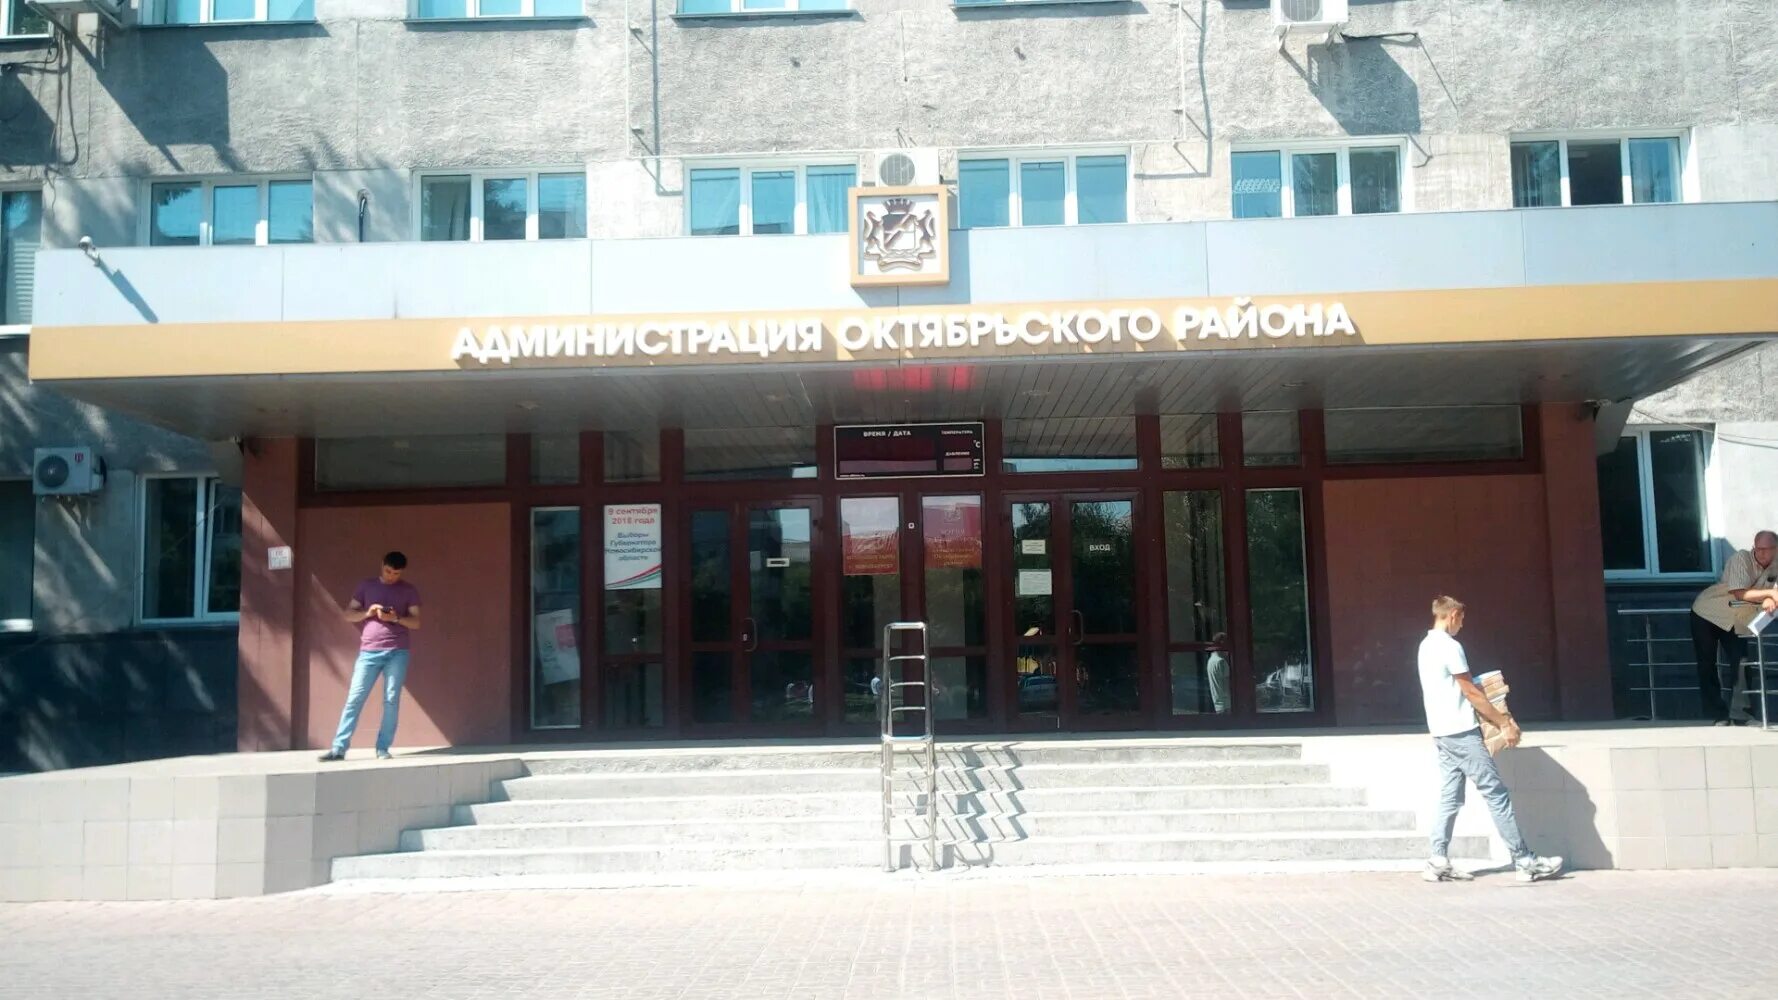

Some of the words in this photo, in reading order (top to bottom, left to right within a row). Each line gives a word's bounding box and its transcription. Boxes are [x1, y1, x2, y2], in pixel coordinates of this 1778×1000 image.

[450, 317, 822, 364] АДМИНИСТРАЦИЯ
[836, 308, 1161, 351] ОКТЯБРЬСКОГО
[1175, 296, 1356, 341] РАЙОНА
[616, 507, 658, 515] сентября
[1089, 543, 1111, 551] ВХОД
